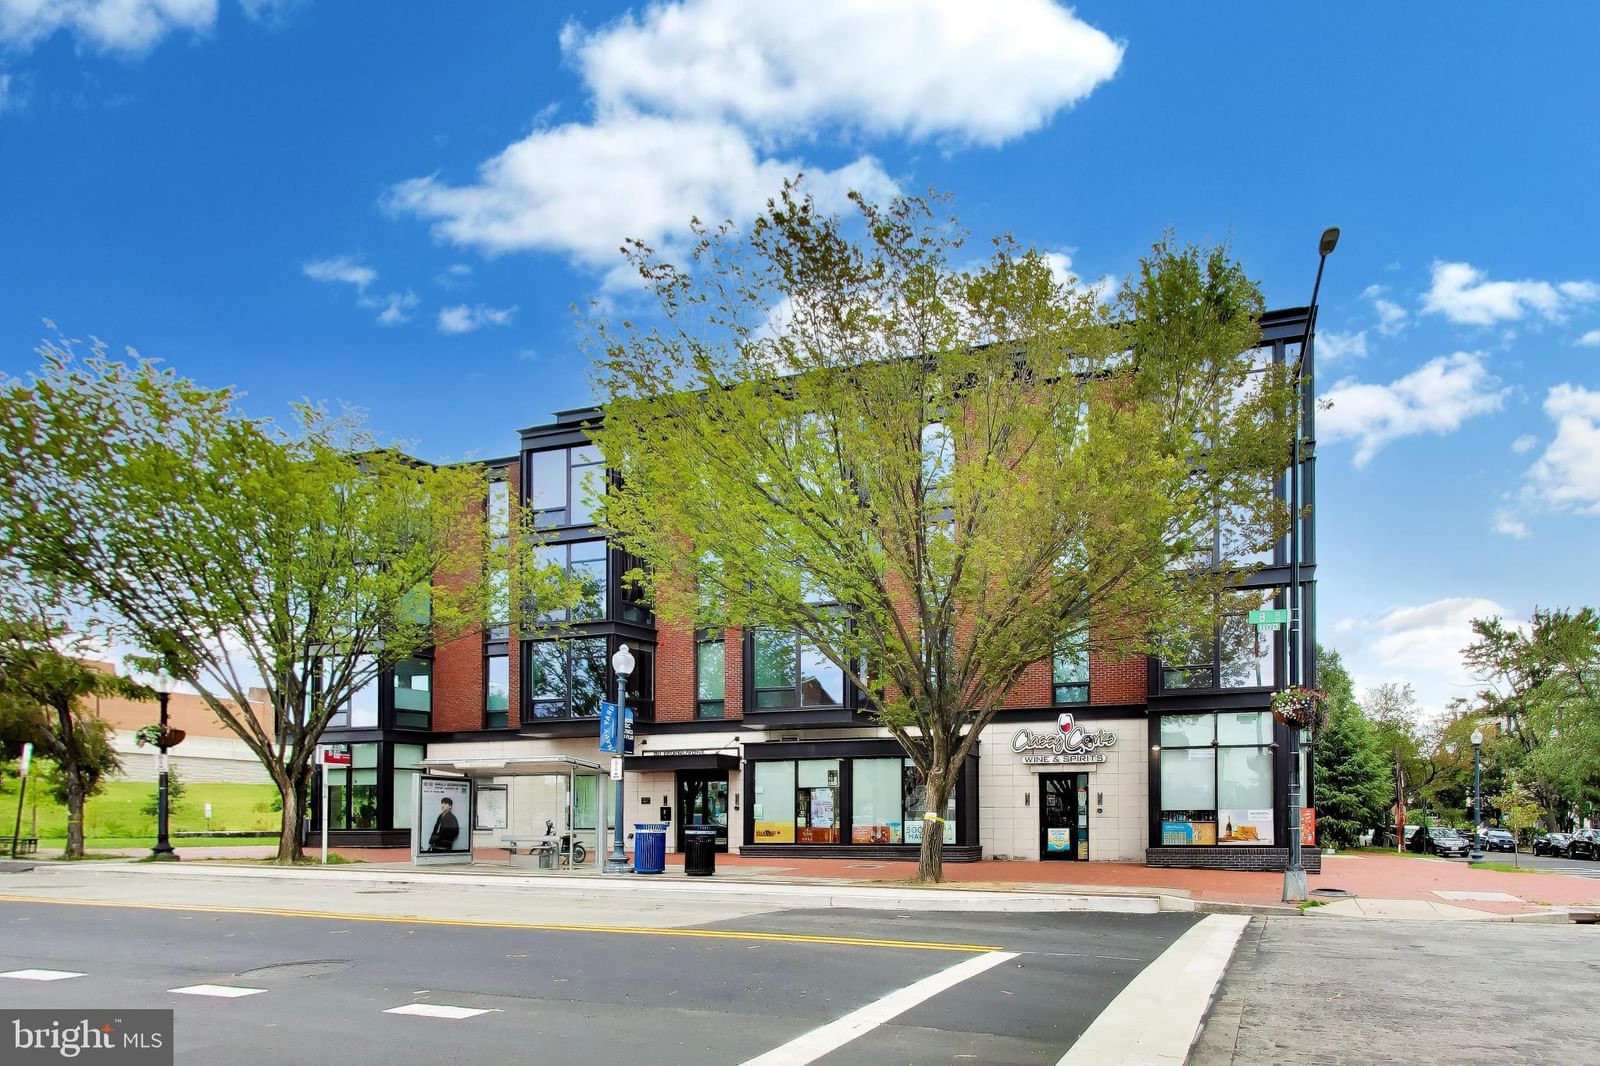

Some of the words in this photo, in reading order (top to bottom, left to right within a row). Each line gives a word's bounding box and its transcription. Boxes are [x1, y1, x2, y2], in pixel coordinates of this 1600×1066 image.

[603, 705, 615, 726] YARD
[603, 728, 613, 751] NAVY
[1012, 728, 1063, 753] Classy
[1065, 725, 1116, 753] Corks
[1063, 754, 1104, 762] SPIRITS
